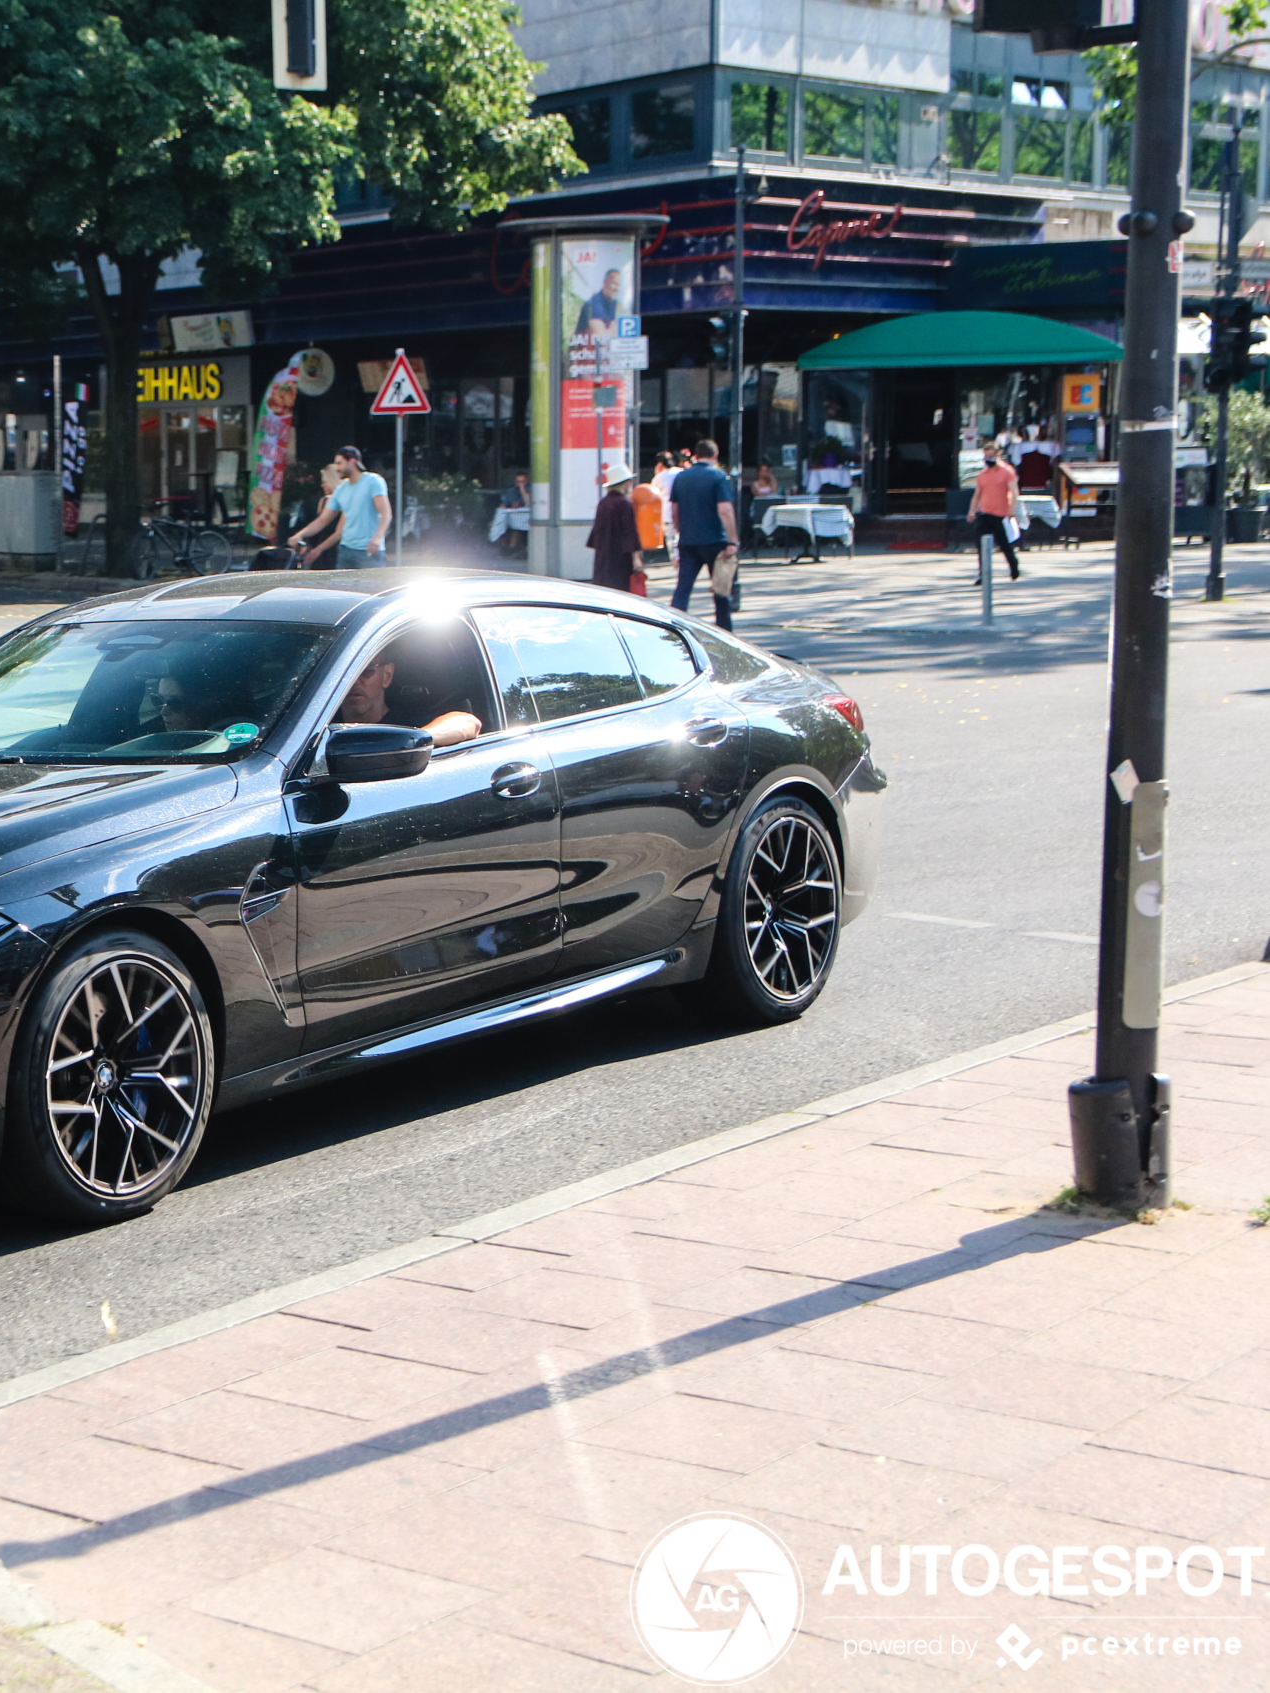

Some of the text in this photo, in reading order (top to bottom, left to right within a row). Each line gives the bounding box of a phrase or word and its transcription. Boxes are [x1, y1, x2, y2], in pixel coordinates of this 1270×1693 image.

[621, 318, 636, 337] P
[1070, 384, 1094, 406] EC
[62, 401, 80, 493] PIZZA
[236, 725, 245, 734] 4
